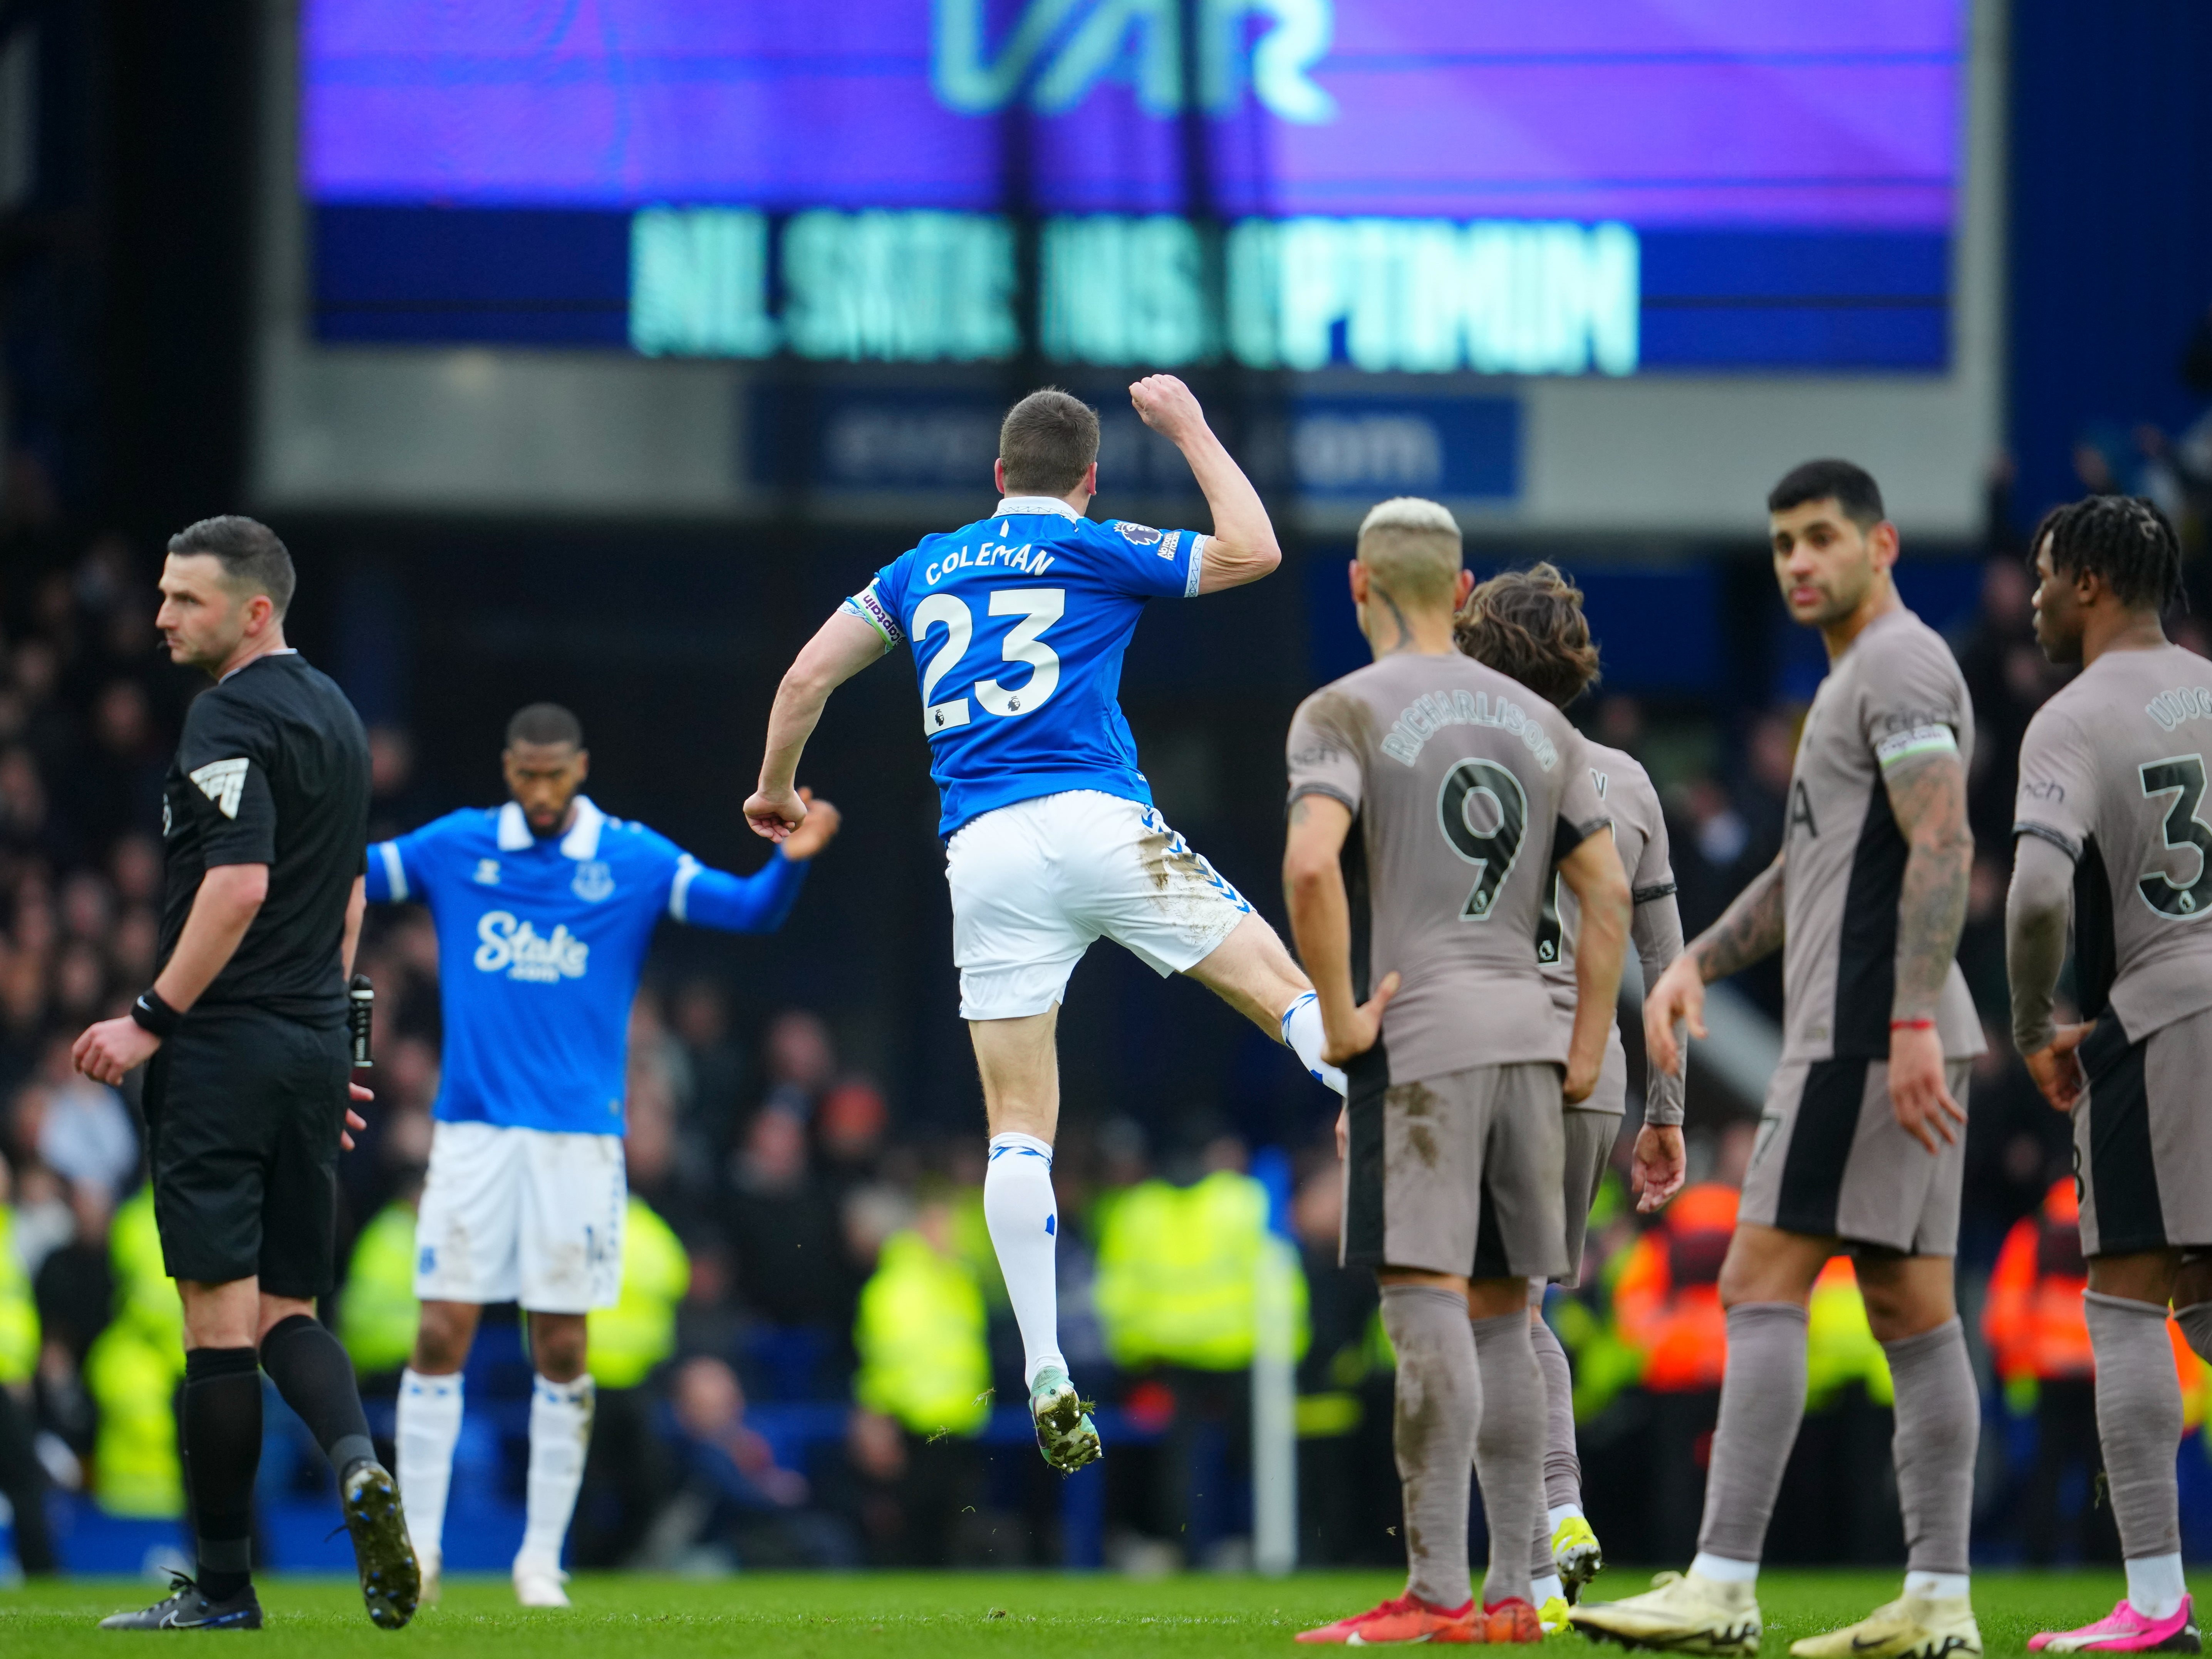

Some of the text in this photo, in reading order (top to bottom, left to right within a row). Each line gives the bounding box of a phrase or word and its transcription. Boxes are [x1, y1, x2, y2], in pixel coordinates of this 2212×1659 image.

[925, 542, 1055, 585] COLEMAN
[1157, 533, 1173, 558] No room
[1165, 532, 1182, 561] for racism
[912, 588, 1066, 737] 23
[1380, 689, 1559, 773] RICHARLISON
[1437, 757, 1528, 921] 9
[2137, 753, 2212, 921] 3
[474, 910, 590, 980] Stake
